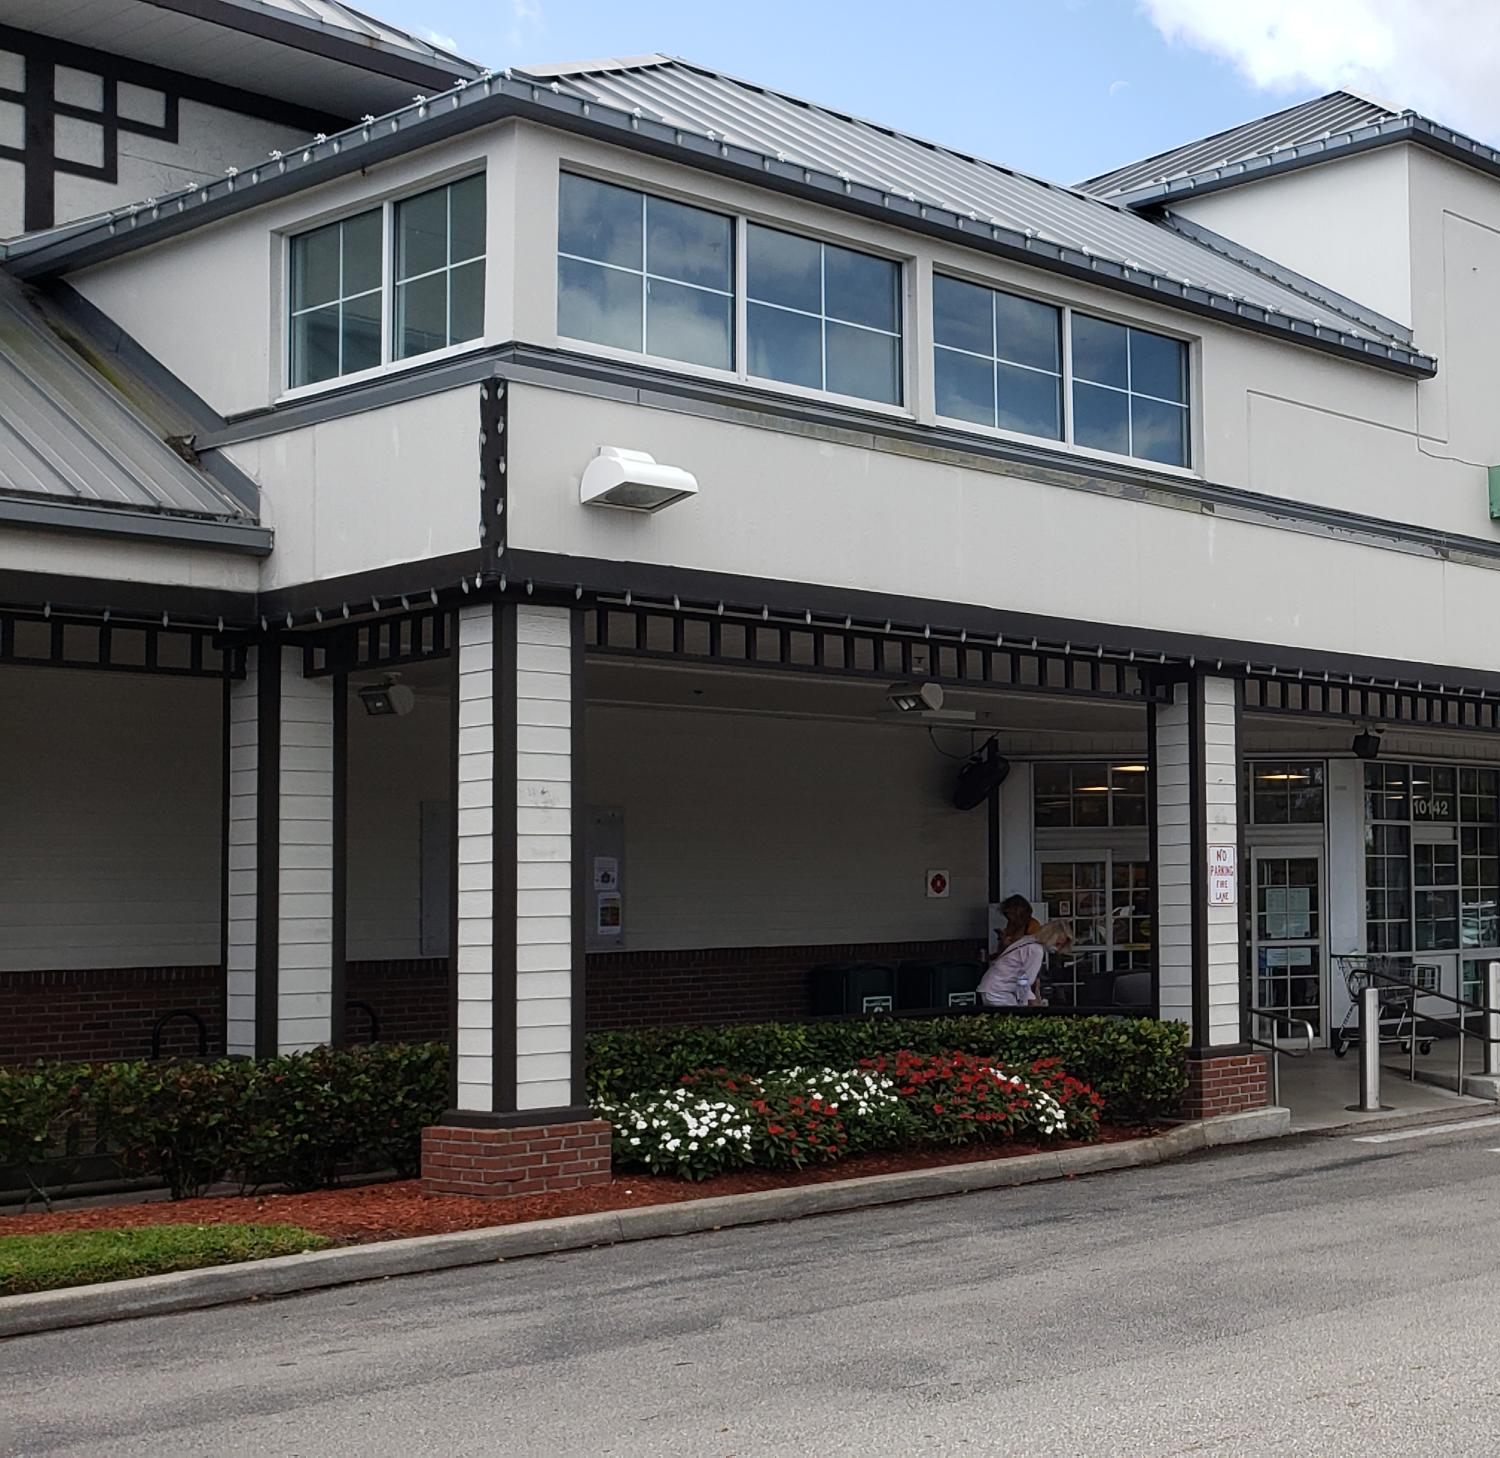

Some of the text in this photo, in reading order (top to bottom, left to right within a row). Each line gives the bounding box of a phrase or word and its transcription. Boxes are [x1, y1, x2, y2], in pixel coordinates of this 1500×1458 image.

[1413, 799, 1449, 816] 10142
[1216, 849, 1228, 862] NO
[1210, 864, 1234, 877] PARKING
[1216, 880, 1229, 889] FIRE
